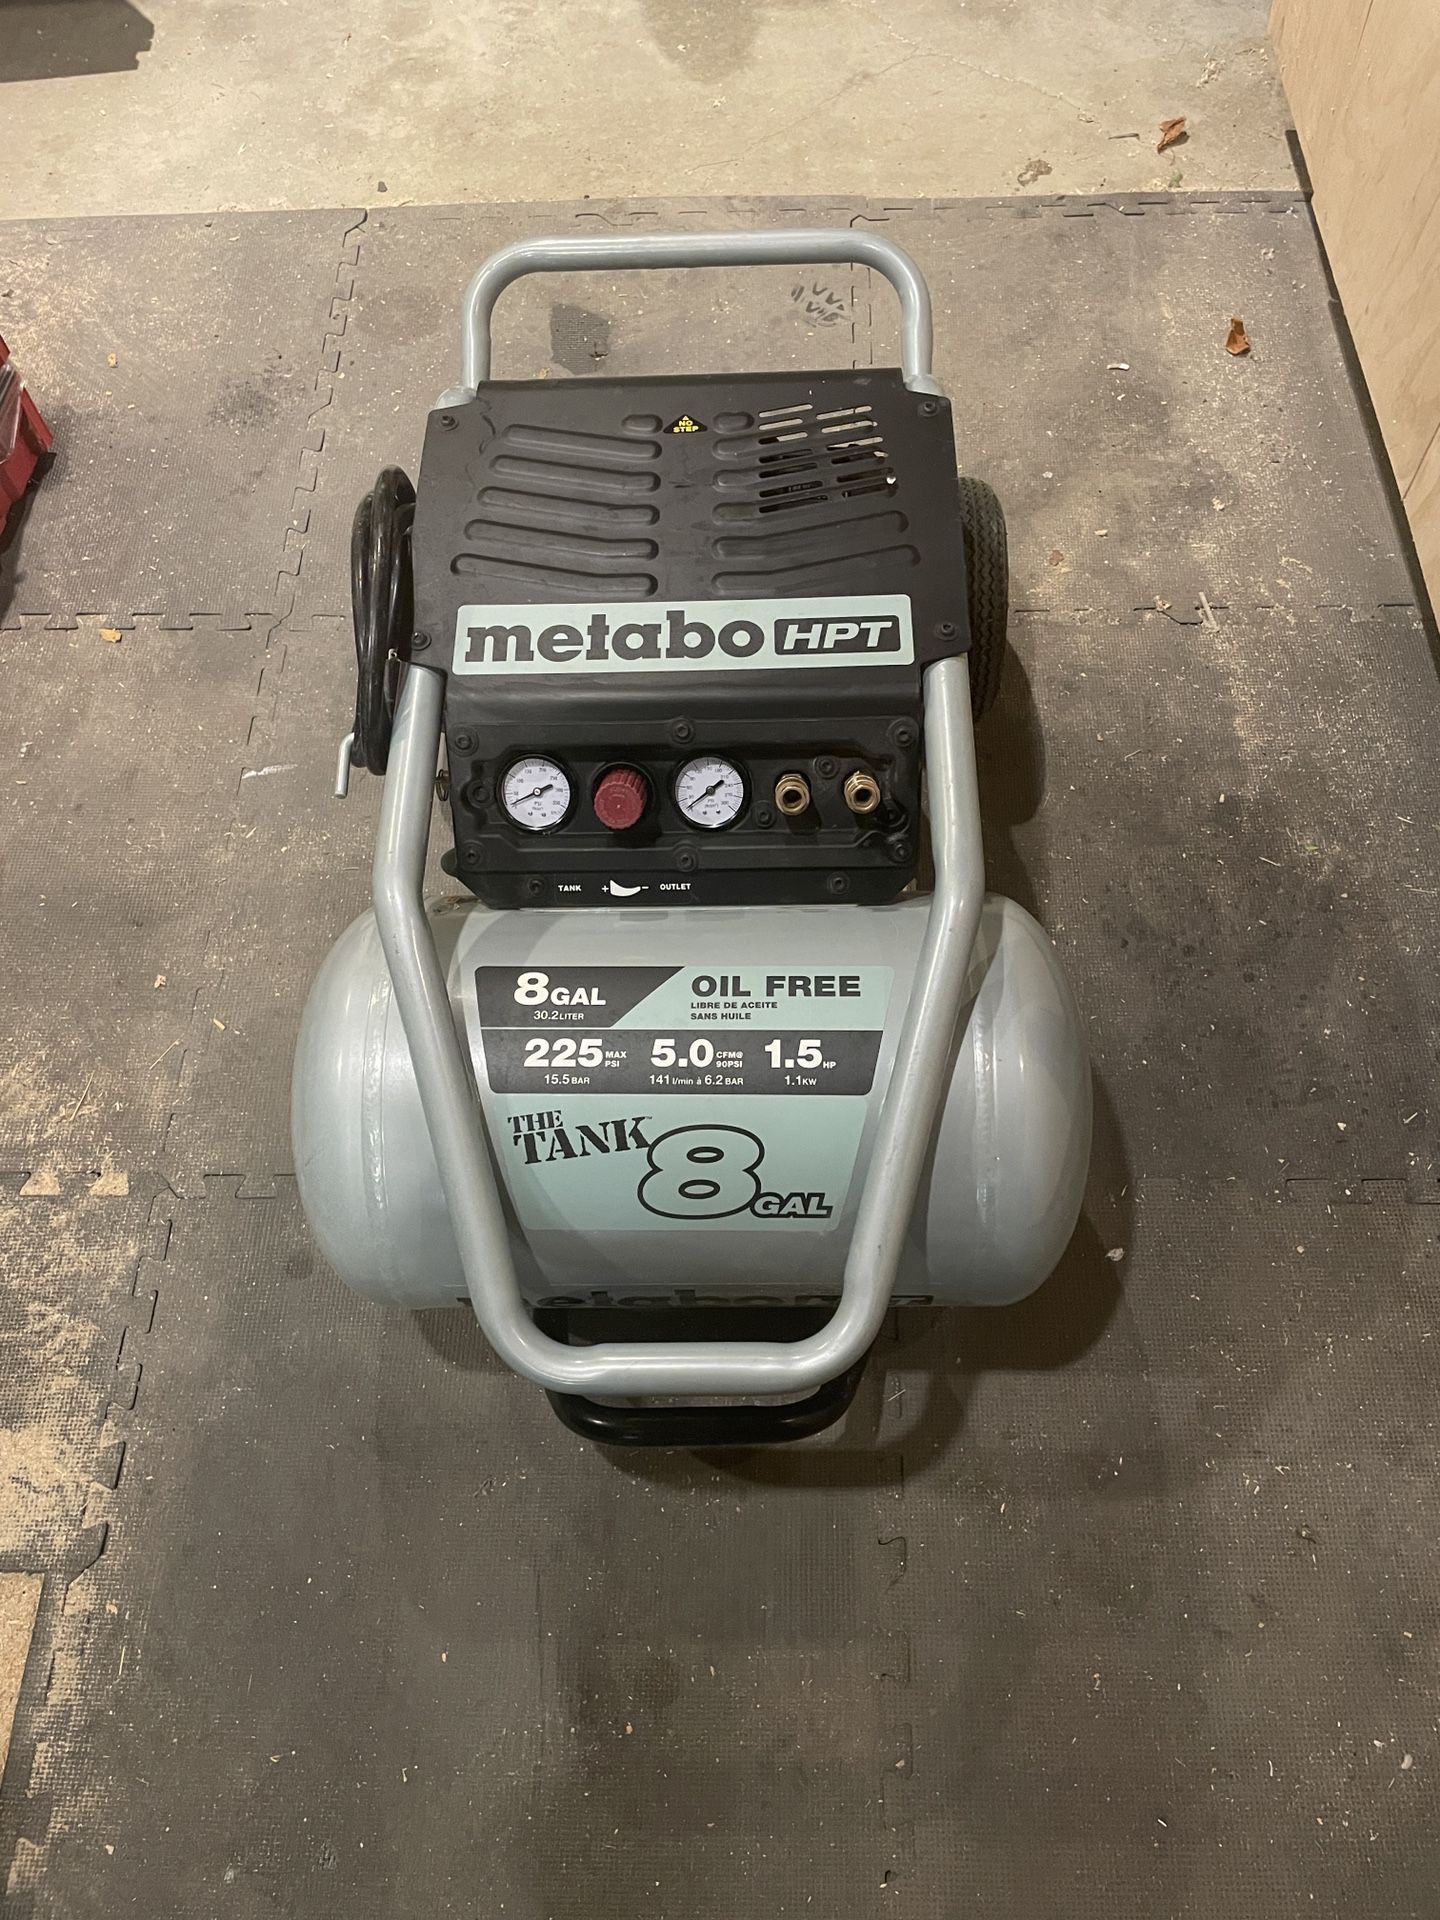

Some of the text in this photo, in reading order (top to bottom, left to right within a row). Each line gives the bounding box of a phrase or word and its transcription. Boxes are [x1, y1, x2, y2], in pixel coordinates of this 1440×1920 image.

[464, 610, 892, 663] metabo HPT
[558, 884, 582, 892] TANK
[659, 883, 692, 891] OUTLET
[691, 975, 861, 997] OIL FREE
[690, 1001, 778, 1009] LIBRE DE ACEITE
[690, 1012, 752, 1020] SANS HUILE
[523, 1038, 627, 1068] 225 MAX
[650, 1038, 714, 1068] 5.0
[605, 1060, 620, 1068] PSI
[716, 1060, 743, 1068] 90PSI
[649, 1075, 671, 1086] 141
[704, 1075, 723, 1086] 6.2
[725, 1077, 744, 1086] BAR
[507, 1110, 563, 1133] THE
[513, 1116, 651, 1164] TANK
